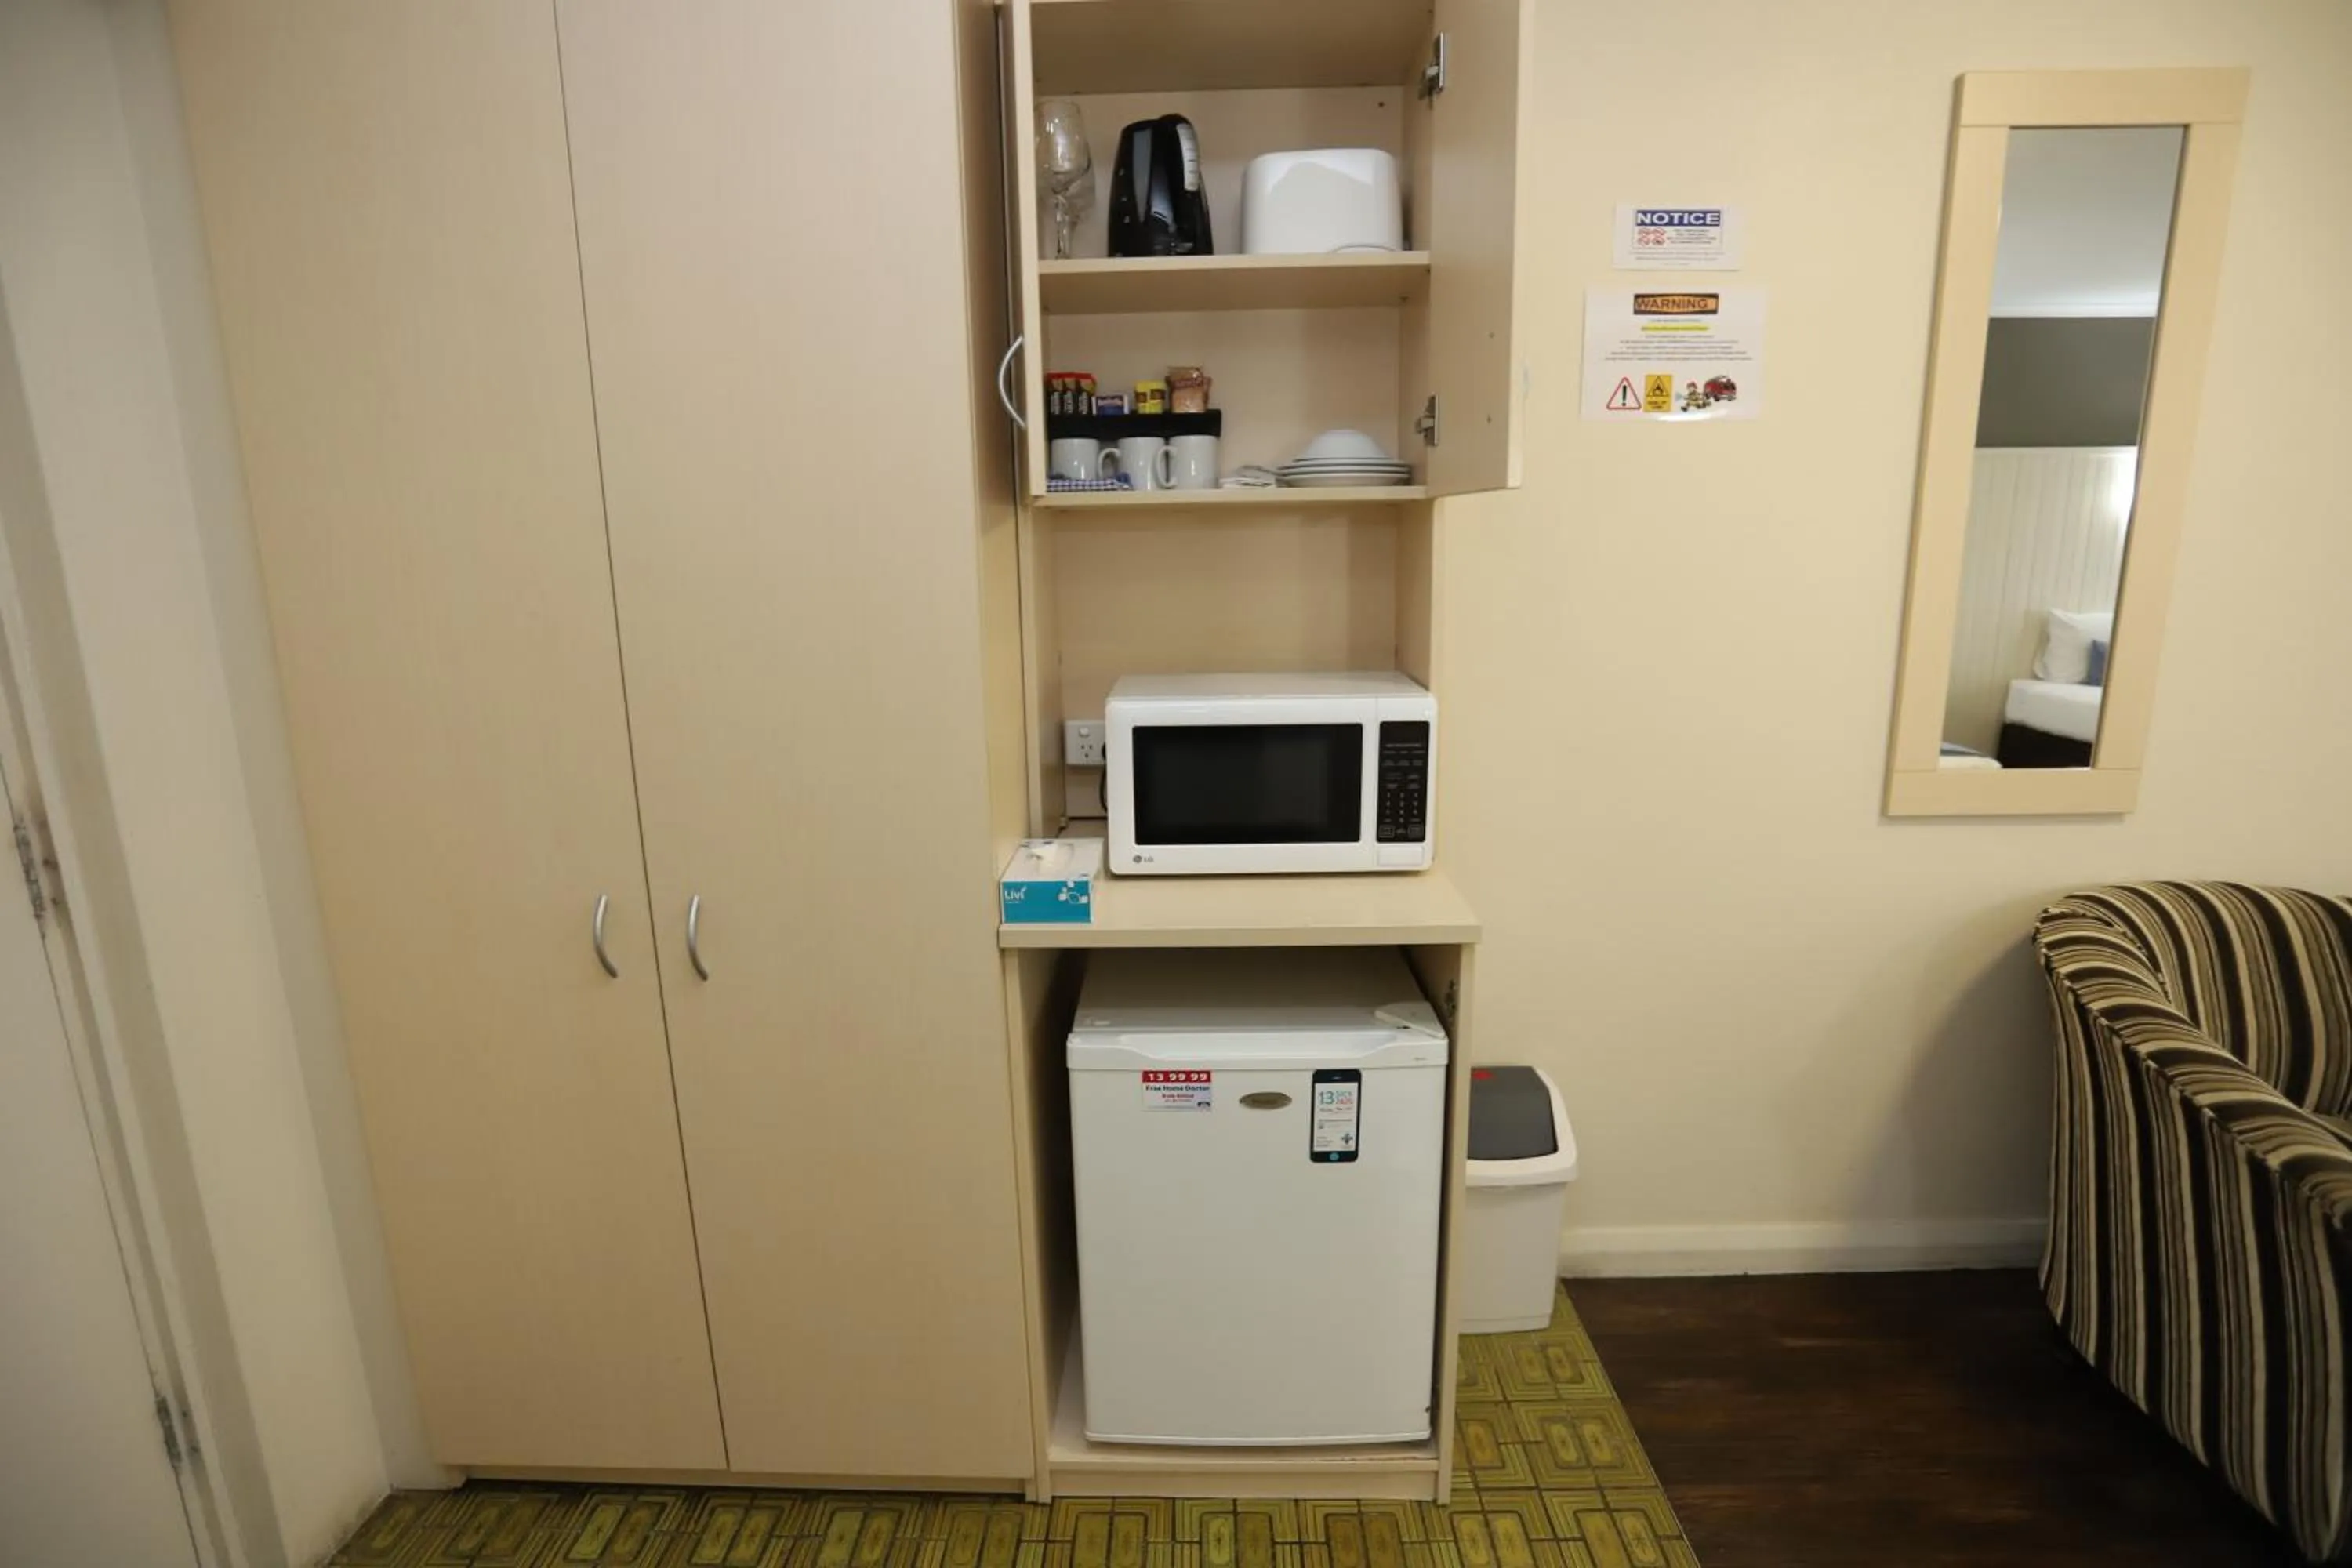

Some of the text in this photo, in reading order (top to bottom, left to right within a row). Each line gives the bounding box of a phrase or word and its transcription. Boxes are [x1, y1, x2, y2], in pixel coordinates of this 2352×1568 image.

[1636, 212, 1720, 225] NOTICE
[1635, 297, 1708, 310] WARNING
[1148, 1073, 1208, 1081] 13 99 99
[1319, 1091, 1334, 1105] 13
